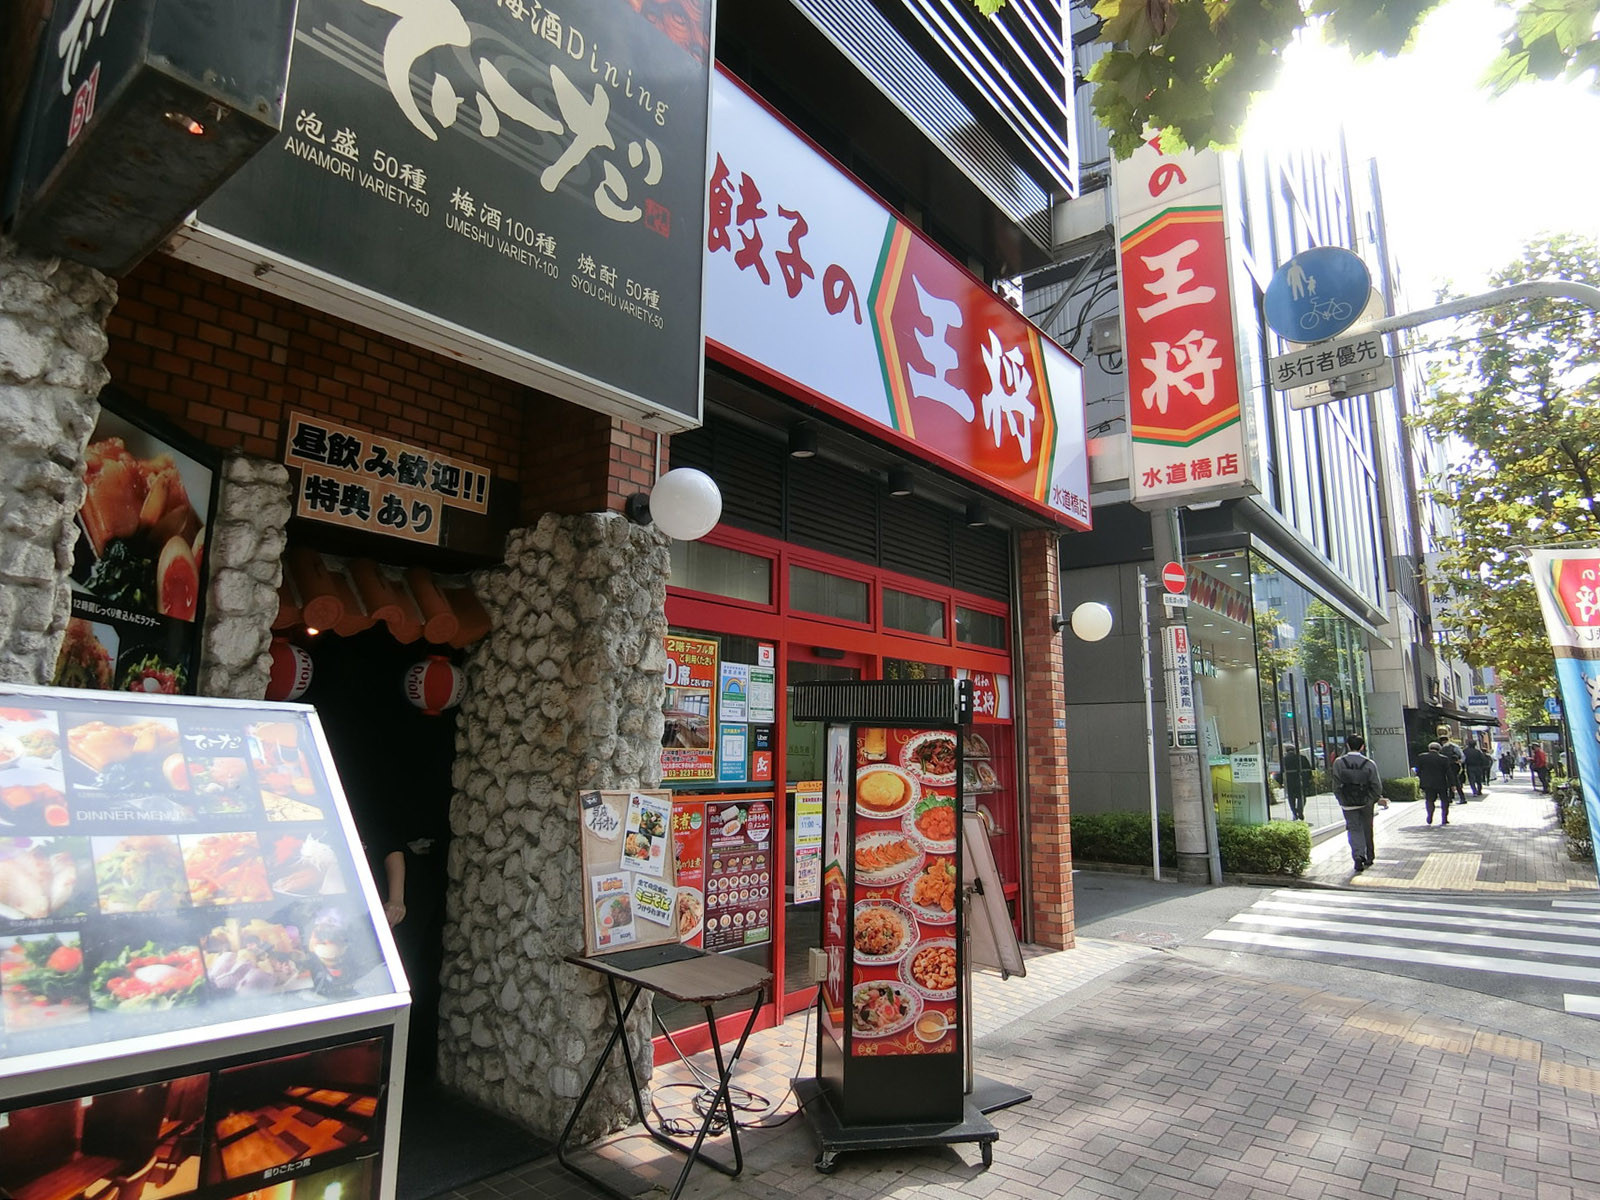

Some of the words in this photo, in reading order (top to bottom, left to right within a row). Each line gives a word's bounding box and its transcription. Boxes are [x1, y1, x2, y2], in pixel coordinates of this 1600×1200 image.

[284, 136, 355, 182] AWAMORI
[358, 169, 430, 218] VARIETY-50
[296, 109, 359, 162] 泡盛
[372, 150, 427, 195] 50種
[445, 212, 494, 249] UMESHU
[496, 236, 559, 280] VARIETY-100
[450, 186, 557, 260] 梅酒100種
[708, 152, 863, 325] 餃子の
[570, 274, 596, 298] SYOU
[598, 286, 617, 307] CHU
[618, 296, 664, 330] VARIETY-50
[577, 252, 618, 289] 焼酎
[625, 278, 661, 311] 50種
[1136, 238, 1223, 415] 王将
[906, 273, 1036, 464] 王将
[1277, 339, 1378, 383] 歩行者優先
[290, 421, 487, 504] 昼飲み歓迎!!
[1141, 453, 1239, 488] 水道橋店
[304, 474, 433, 534] 特典あり
[1052, 484, 1088, 520] 水道橋店
[297, 649, 312, 691] Orion
[408, 665, 424, 700] Orion
[1177, 654, 1192, 708] 水道橋薬局
[972, 689, 995, 715] 王将
[76, 810, 135, 822] DINNER
[635, 887, 673, 912] ミニそば
